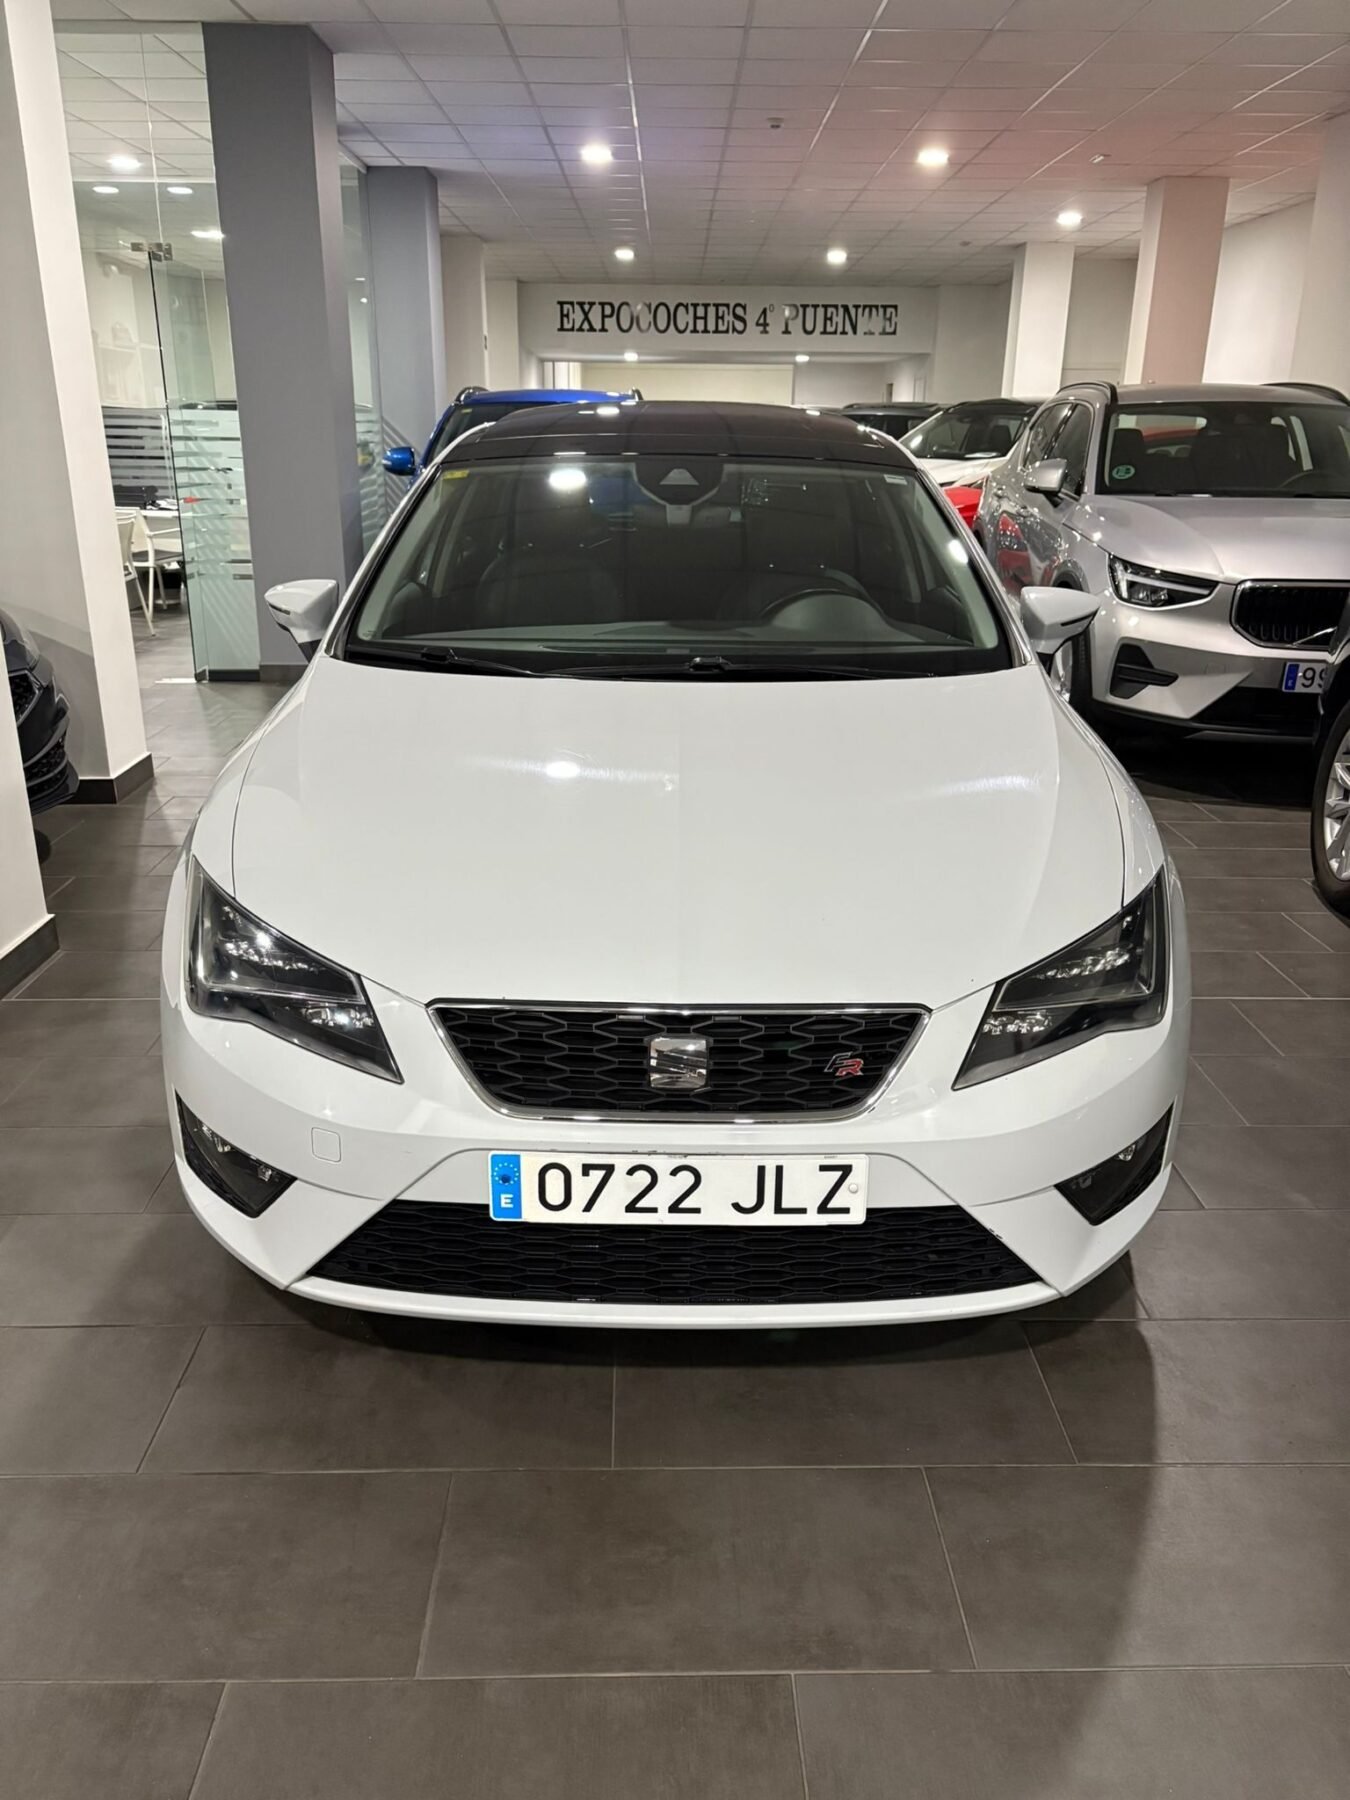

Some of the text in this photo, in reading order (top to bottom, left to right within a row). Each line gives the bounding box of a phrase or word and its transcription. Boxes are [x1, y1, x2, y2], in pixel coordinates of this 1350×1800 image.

[556, 300, 748, 335] EXPOCOCHES
[782, 303, 898, 335] PUENTE
[824, 1051, 864, 1076] FR
[500, 1193, 514, 1208] E
[537, 1162, 854, 1215] 0722 JLZ
